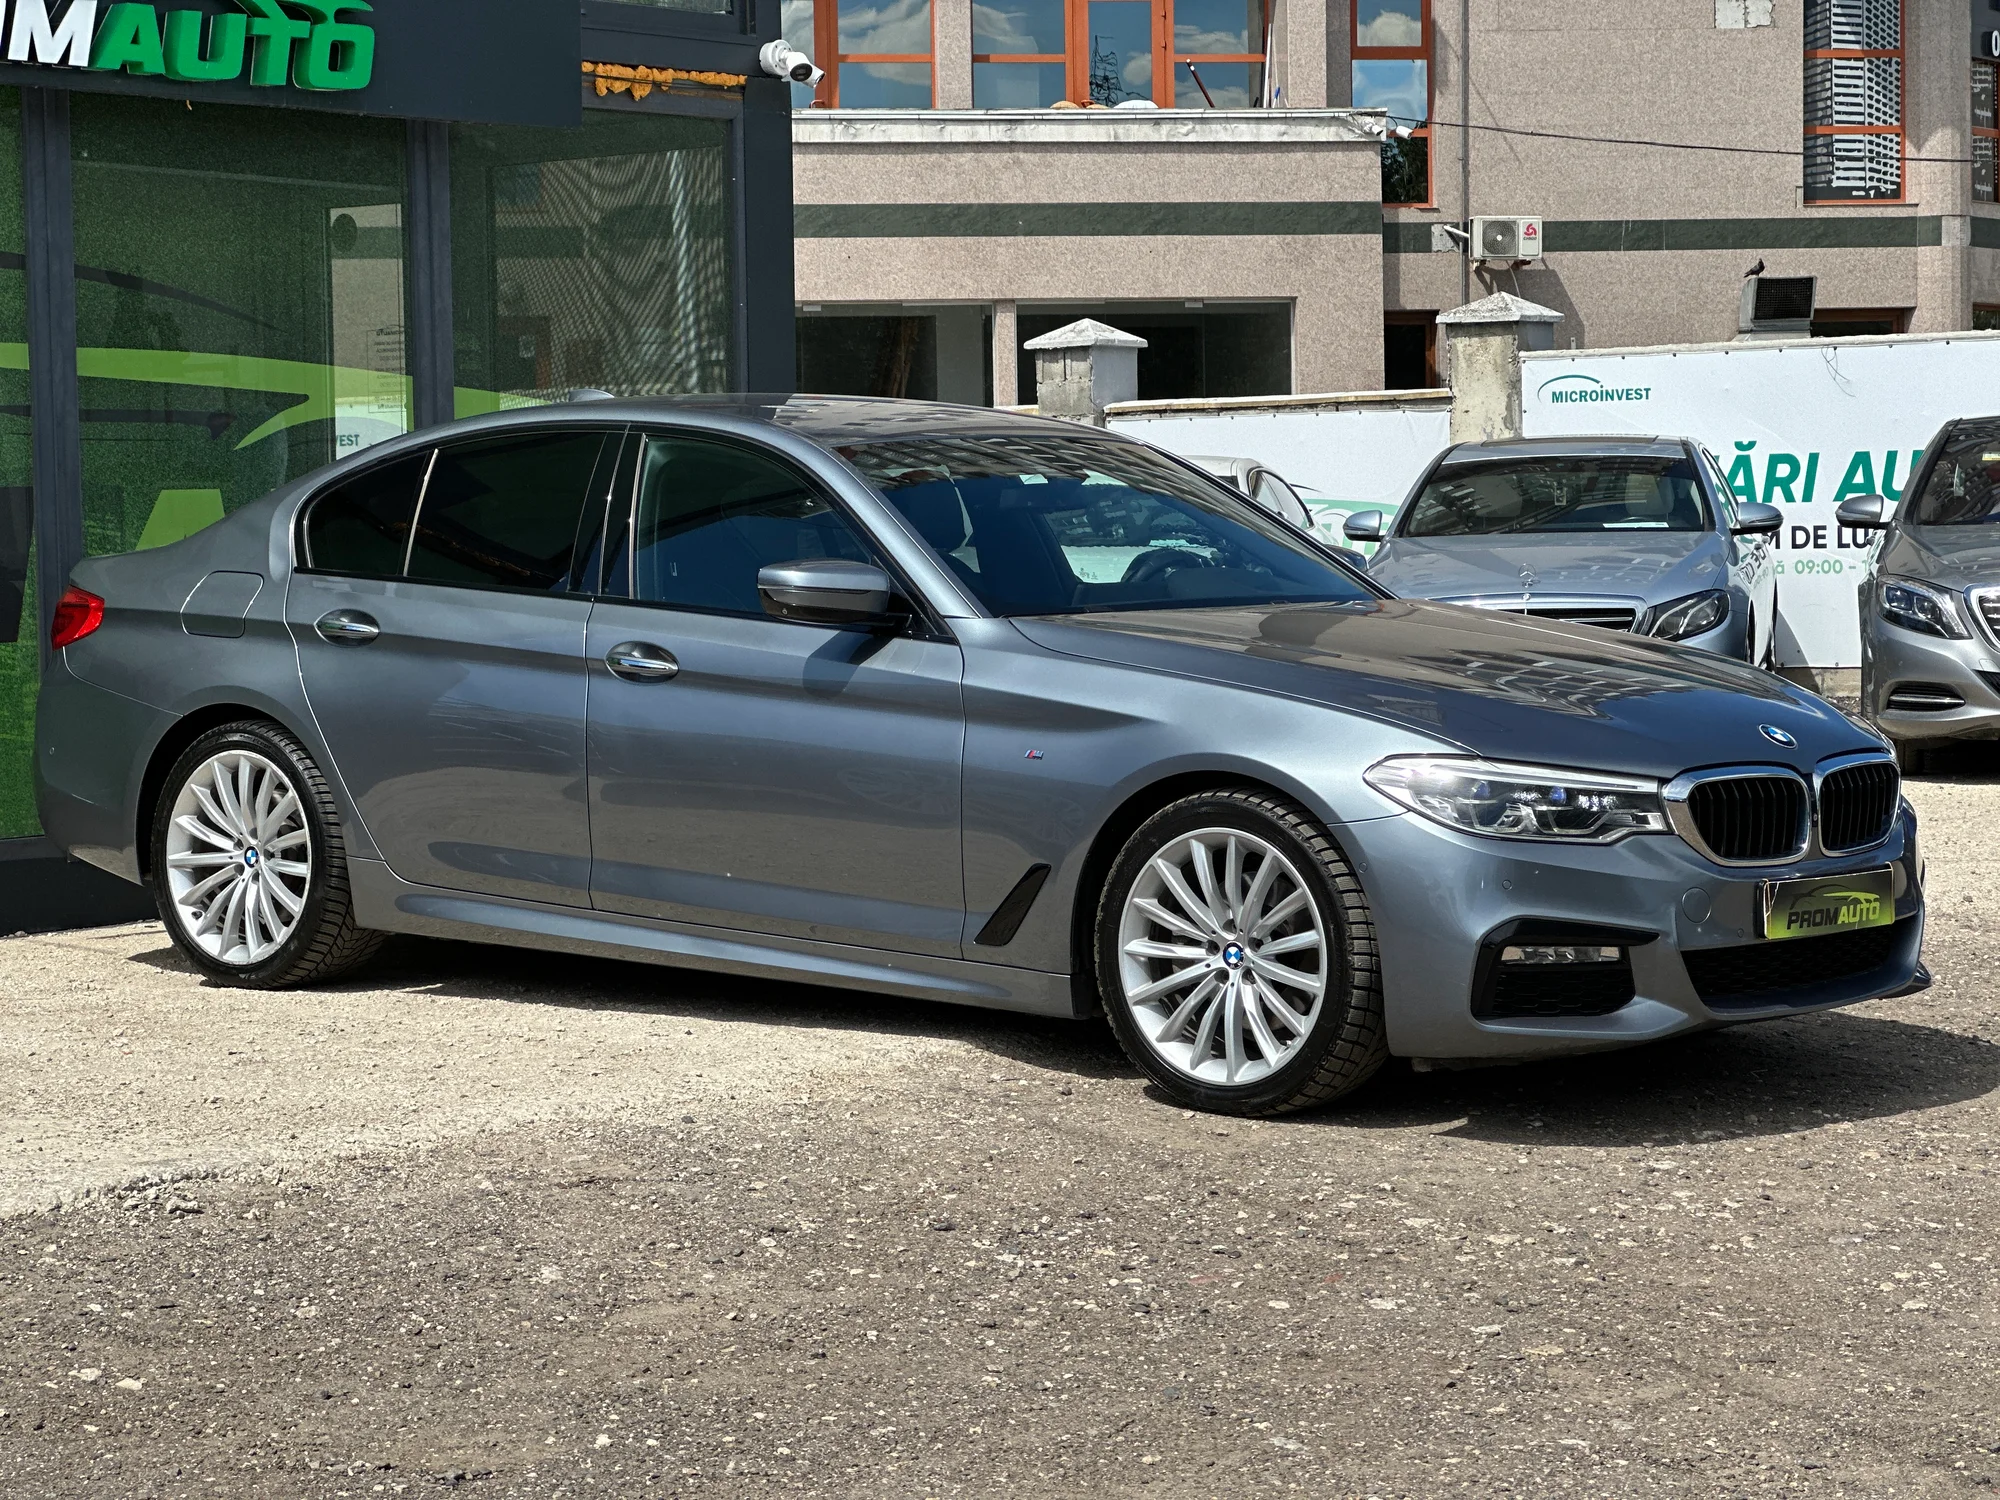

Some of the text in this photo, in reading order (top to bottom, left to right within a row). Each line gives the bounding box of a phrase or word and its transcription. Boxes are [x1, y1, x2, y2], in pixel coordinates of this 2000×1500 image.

[0, 0, 375, 91] MAUTO
[1713, 440, 1820, 503] ĂRI
[1791, 525, 1827, 549] DE
[1794, 559, 1844, 575] 09:00
[1786, 901, 1880, 930] PROMAUTO
